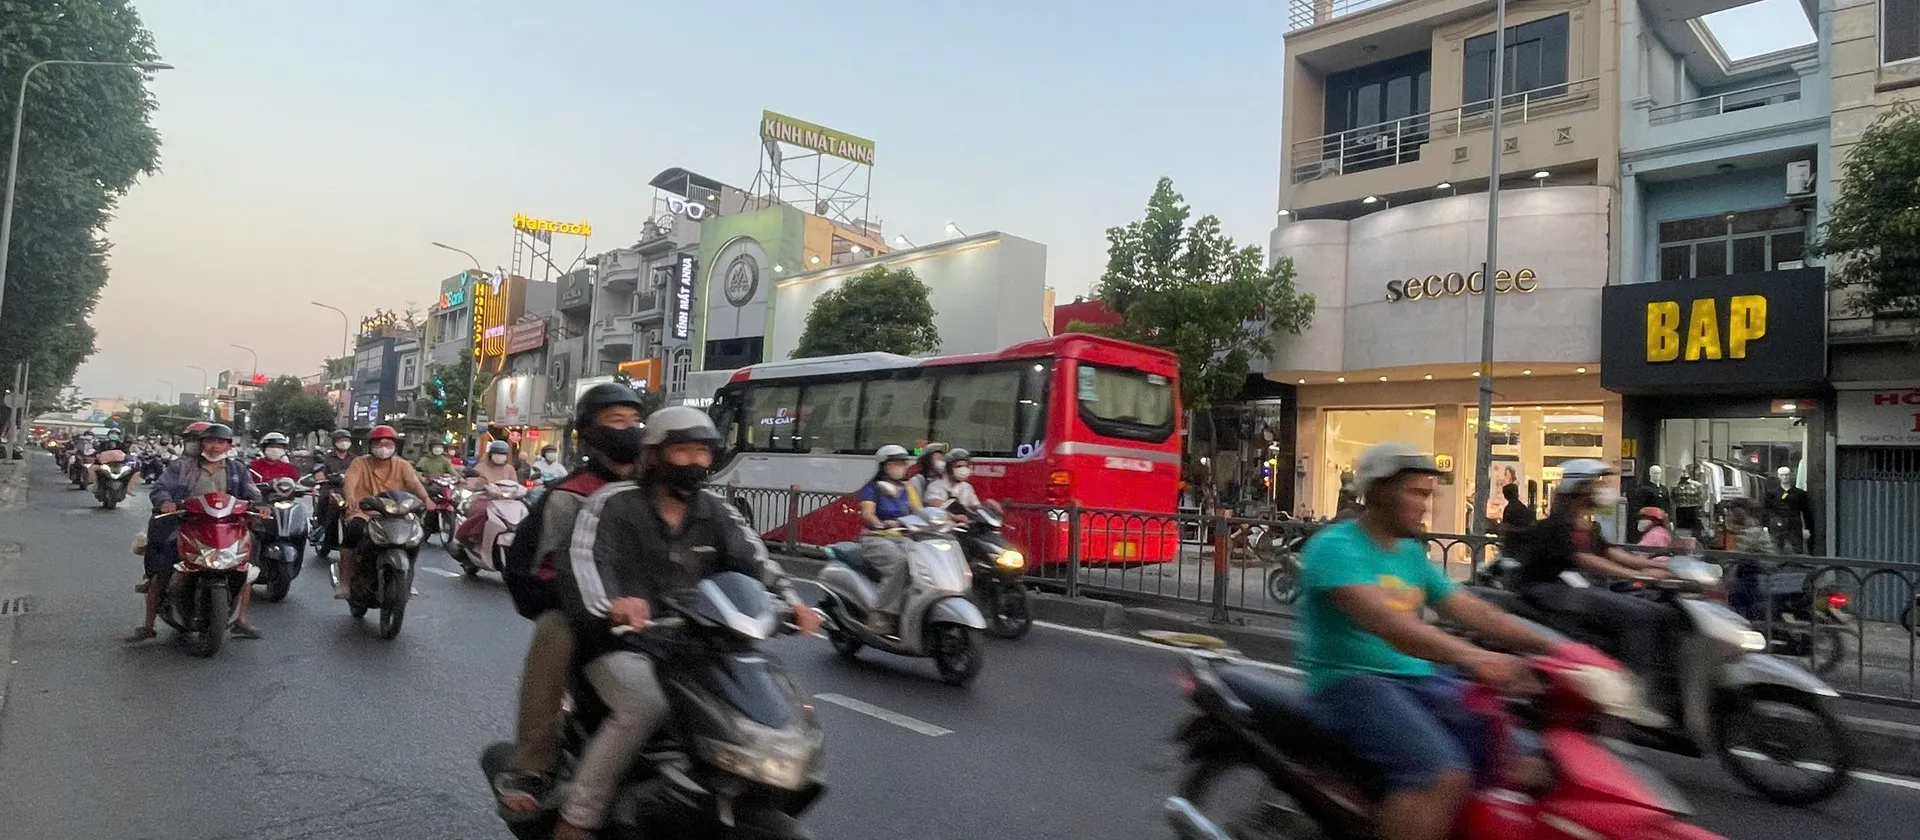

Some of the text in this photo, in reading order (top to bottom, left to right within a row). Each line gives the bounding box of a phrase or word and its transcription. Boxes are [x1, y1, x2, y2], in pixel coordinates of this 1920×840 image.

[765, 117, 801, 143] KÍNH
[838, 141, 873, 162] ANNA
[681, 257, 693, 286] ANNA
[1385, 261, 1538, 303] secodee
[1647, 295, 1767, 362] BAP
[683, 398, 700, 406] ANNA
[1438, 459, 1451, 469] 89
